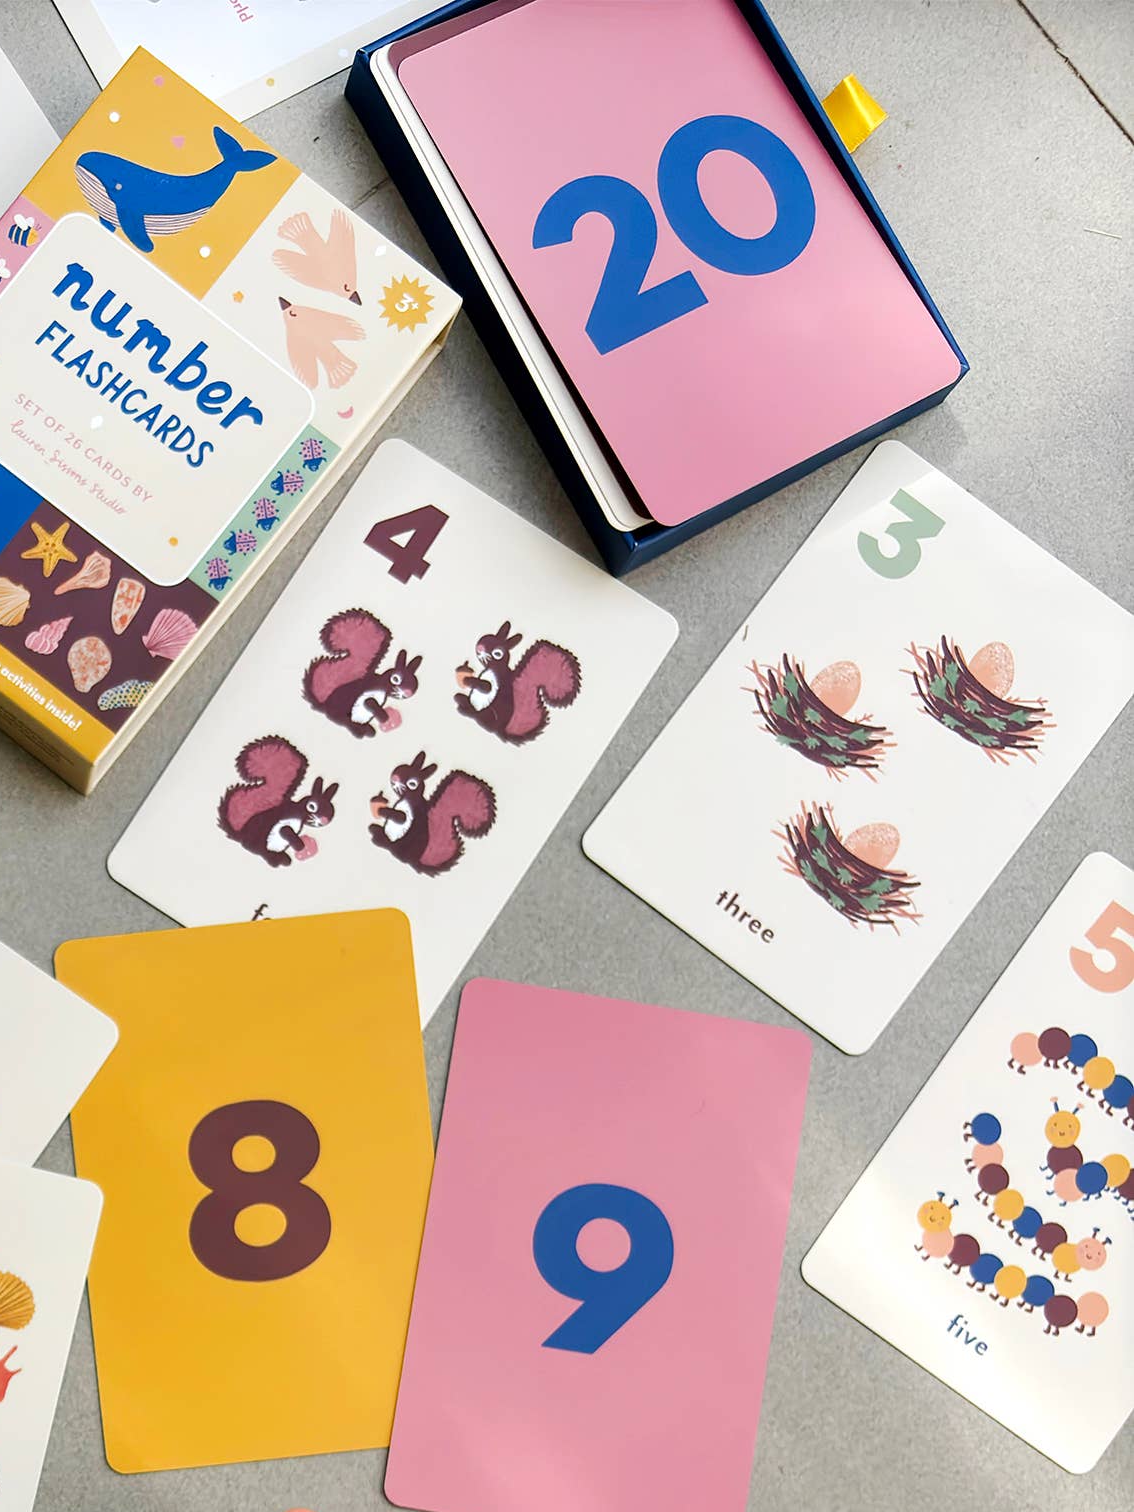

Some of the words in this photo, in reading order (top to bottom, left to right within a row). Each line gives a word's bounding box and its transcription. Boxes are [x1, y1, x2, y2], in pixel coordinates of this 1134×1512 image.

[533, 114, 816, 355] 20
[52, 262, 263, 429] number
[394, 292, 419, 313] 3+
[34, 320, 214, 468] FLASHCARDS
[15, 393, 43, 416] SET
[44, 416, 66, 433] OF
[64, 432, 83, 450] 26
[84, 447, 132, 488] CARDS
[132, 485, 153, 502] BY
[363, 504, 450, 585] 4
[857, 488, 946, 580] 3
[0, 665, 46, 706] activities
[44, 699, 83, 732] inside!
[716, 890, 775, 943] three
[1069, 899, 1134, 993] 5
[189, 1100, 332, 1283] 8
[533, 1183, 674, 1354] 9
[947, 1314, 988, 1356] five
